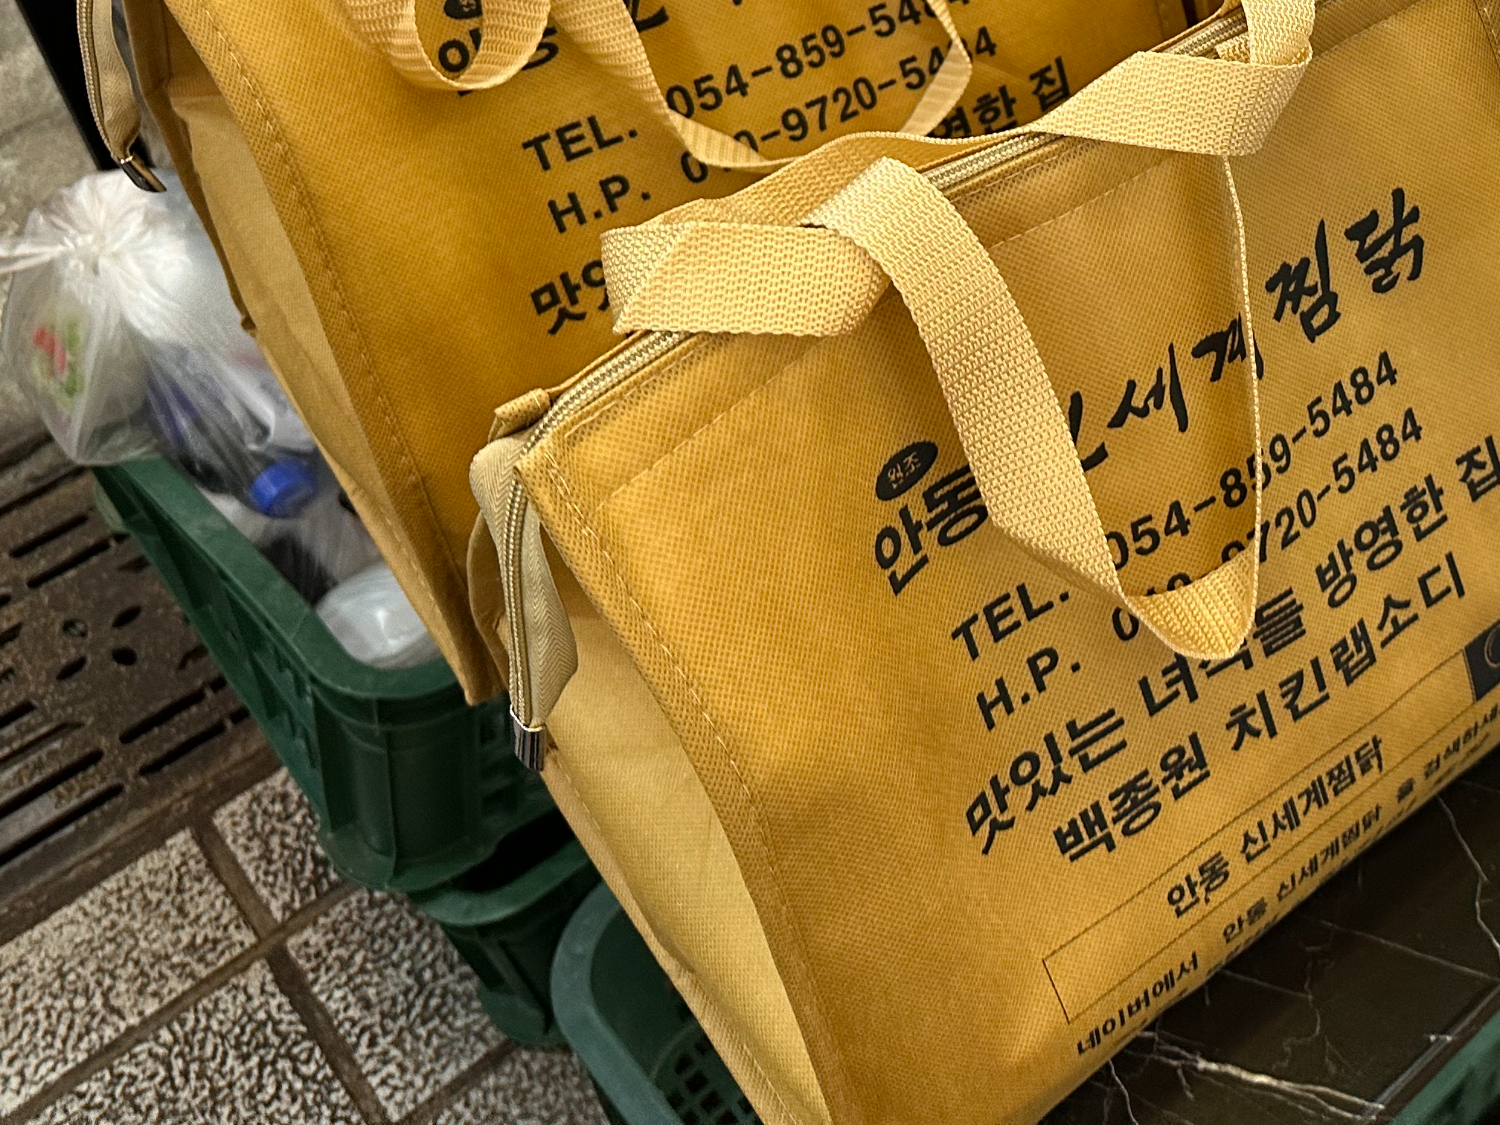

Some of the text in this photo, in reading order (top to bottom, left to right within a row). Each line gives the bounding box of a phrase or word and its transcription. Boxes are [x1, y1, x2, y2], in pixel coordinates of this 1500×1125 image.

[521, 115, 637, 171] TEL.
[1028, 56, 1071, 113] 집
[547, 174, 650, 233] H.P.
[874, 464, 987, 593] 안동
[951, 352, 1396, 660] TEL. 054-859-5484
[966, 709, 1126, 853] 맛있는
[1315, 475, 1447, 607] 방영한
[976, 646, 1080, 731] H.P.
[1054, 553, 1464, 860] 백종원 치킨랩소디
[1166, 735, 1383, 917] 안동 신세계찜닭
[1076, 951, 1198, 1054] 네이버에서
[1222, 897, 1268, 944] 안동
[1276, 804, 1382, 901] 신세계찜닭
